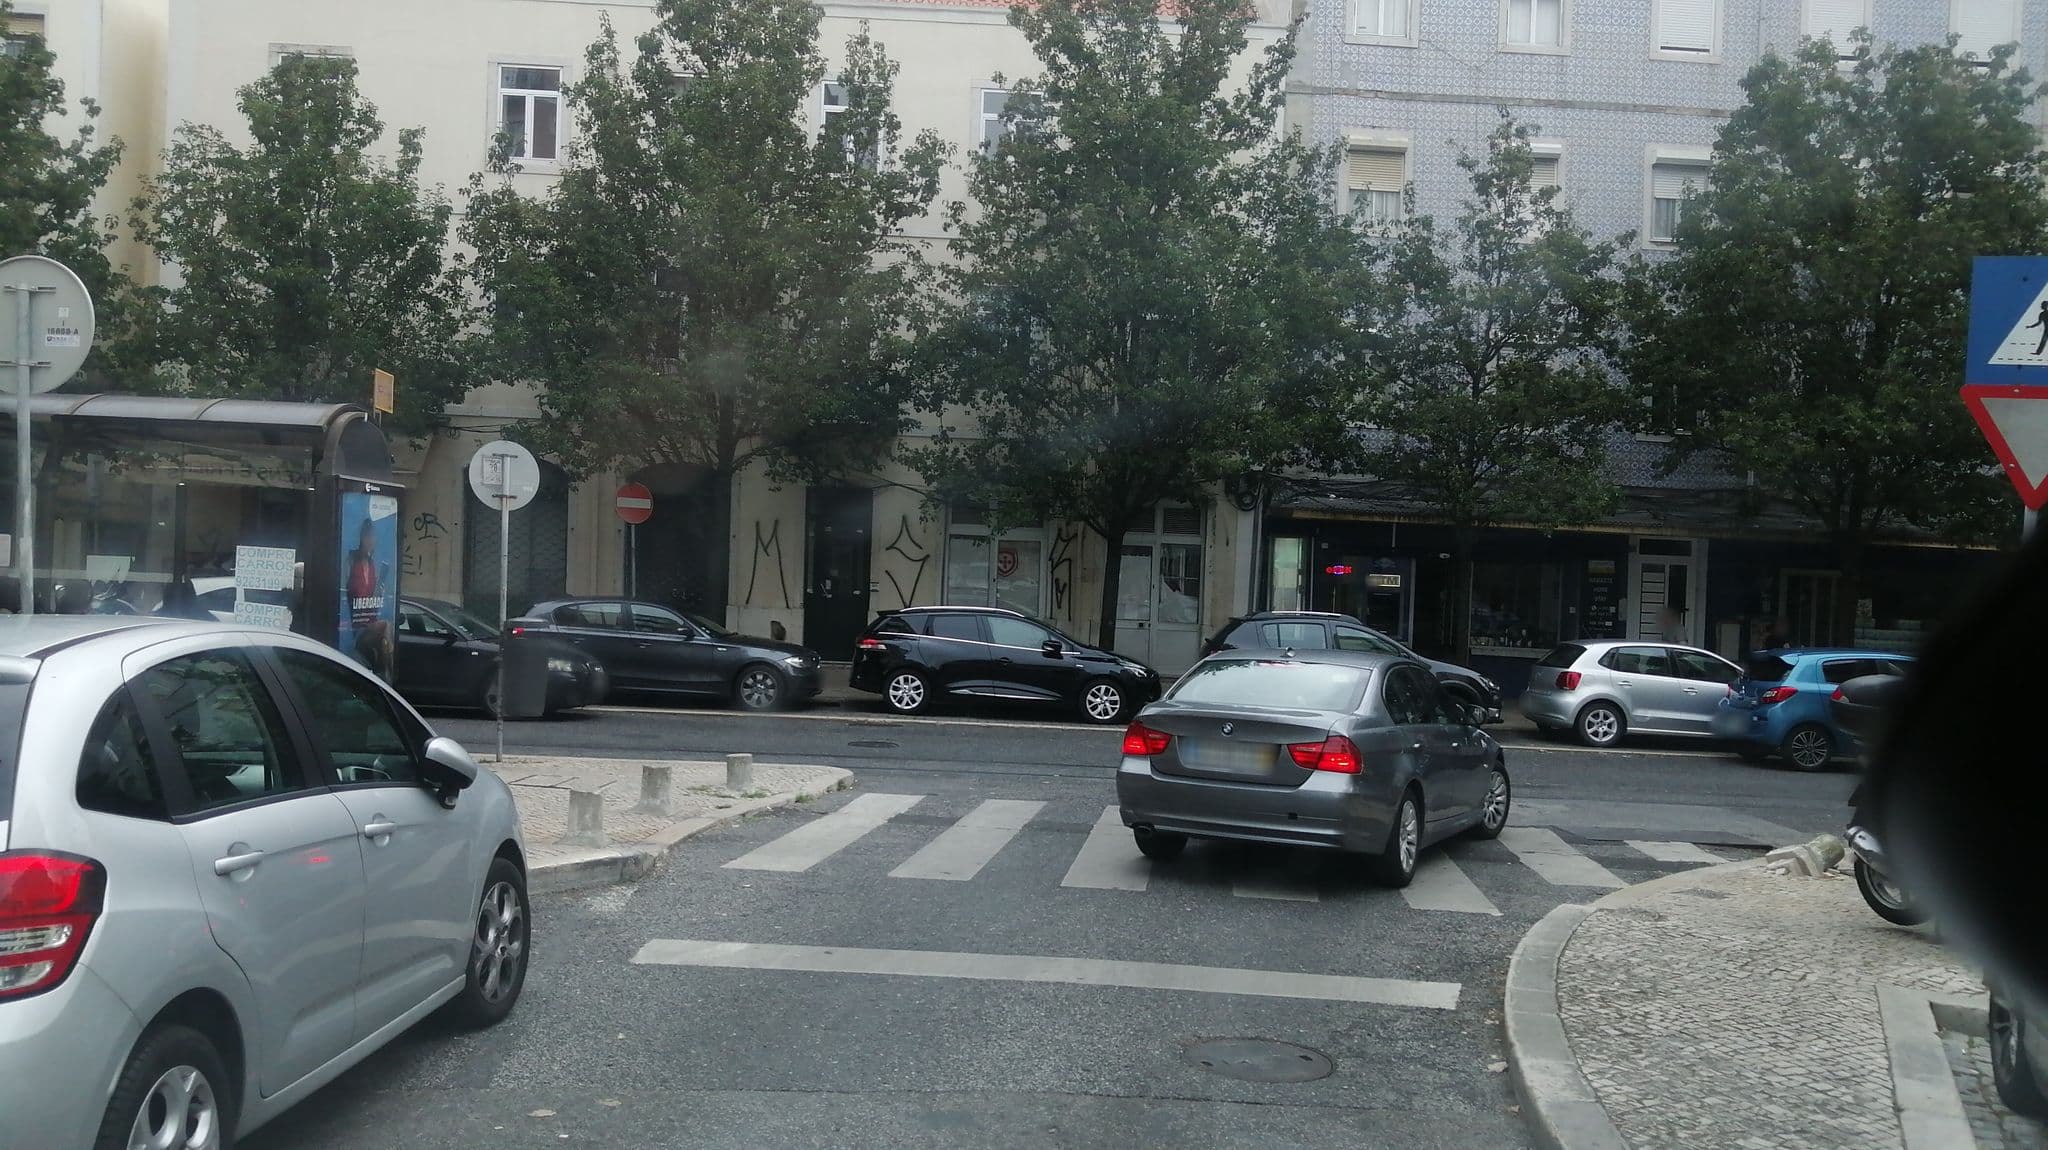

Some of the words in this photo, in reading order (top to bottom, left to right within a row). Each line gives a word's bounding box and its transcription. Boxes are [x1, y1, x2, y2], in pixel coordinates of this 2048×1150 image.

[238, 548, 294, 560] COMPRO
[237, 559, 294, 571] CARROS
[236, 603, 287, 616] COMPR
[353, 597, 384, 610] LIBERDADE
[235, 616, 288, 627] CARRO
